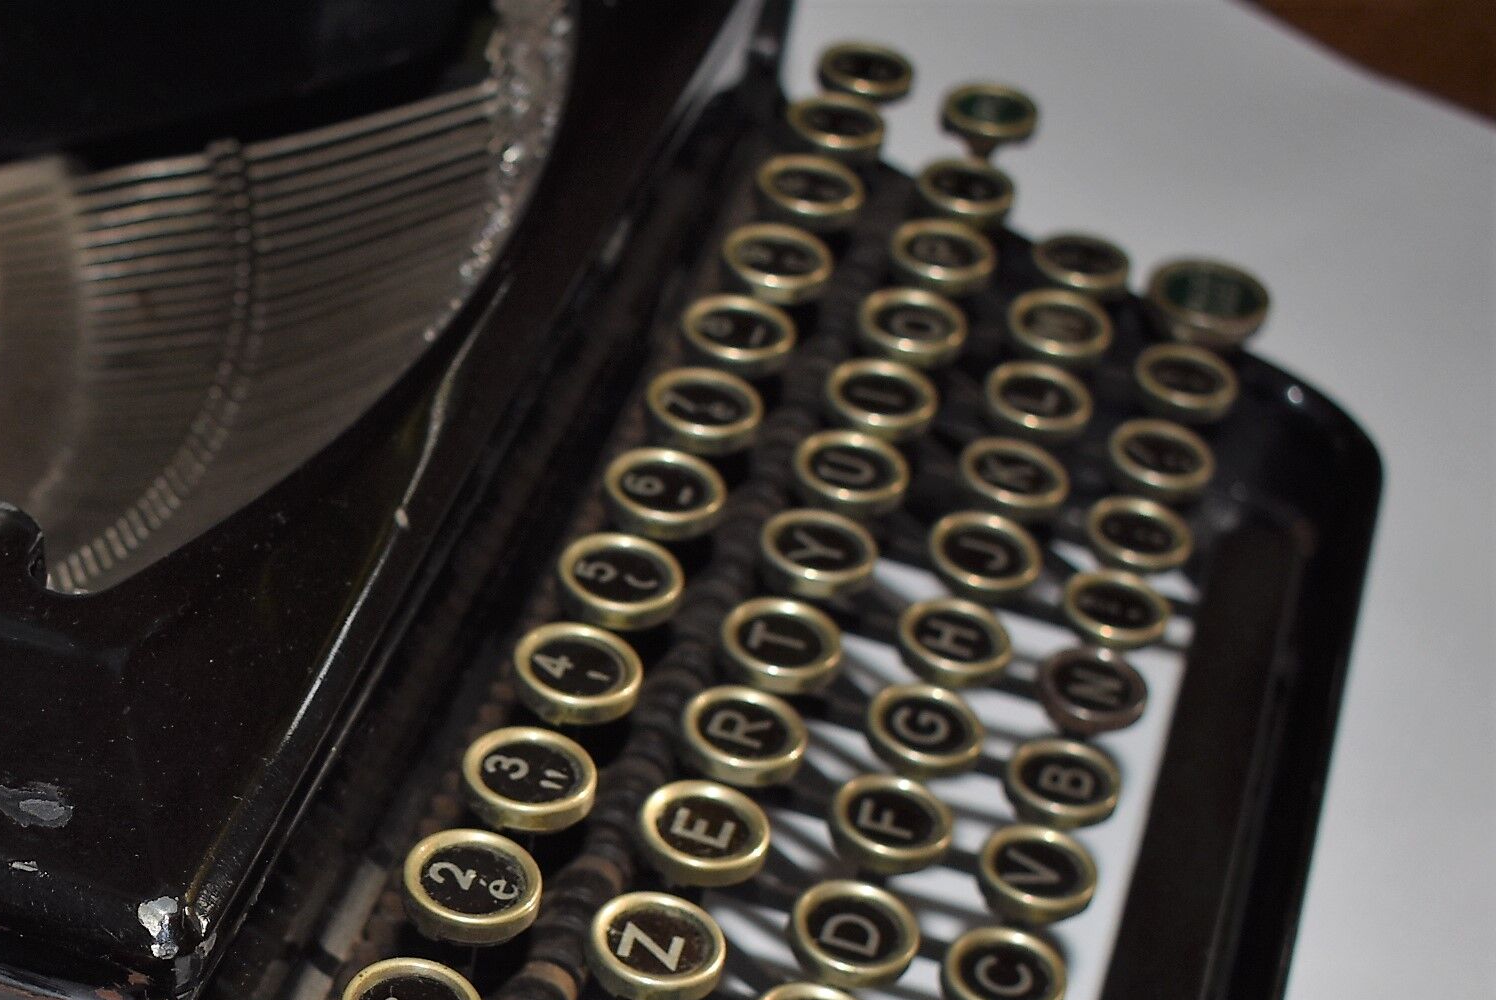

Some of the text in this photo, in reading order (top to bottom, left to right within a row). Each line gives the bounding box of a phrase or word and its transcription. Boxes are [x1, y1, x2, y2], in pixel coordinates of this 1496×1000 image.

[621, 472, 665, 497] 6
[815, 451, 875, 486] U
[785, 530, 845, 561] Y
[958, 535, 1008, 571] J
[575, 560, 618, 584] 5
[747, 620, 808, 650] T
[916, 616, 981, 660] H
[533, 653, 575, 680] 4
[706, 708, 774, 749] R
[891, 705, 951, 746] G
[483, 754, 530, 782] 3
[1037, 762, 1096, 800] B
[669, 806, 736, 850] E
[856, 797, 913, 841] F
[428, 861, 478, 892] 2
[1001, 846, 1061, 886] V
[616, 921, 685, 973] Z
[818, 912, 881, 958] D
[974, 954, 1035, 997] C
